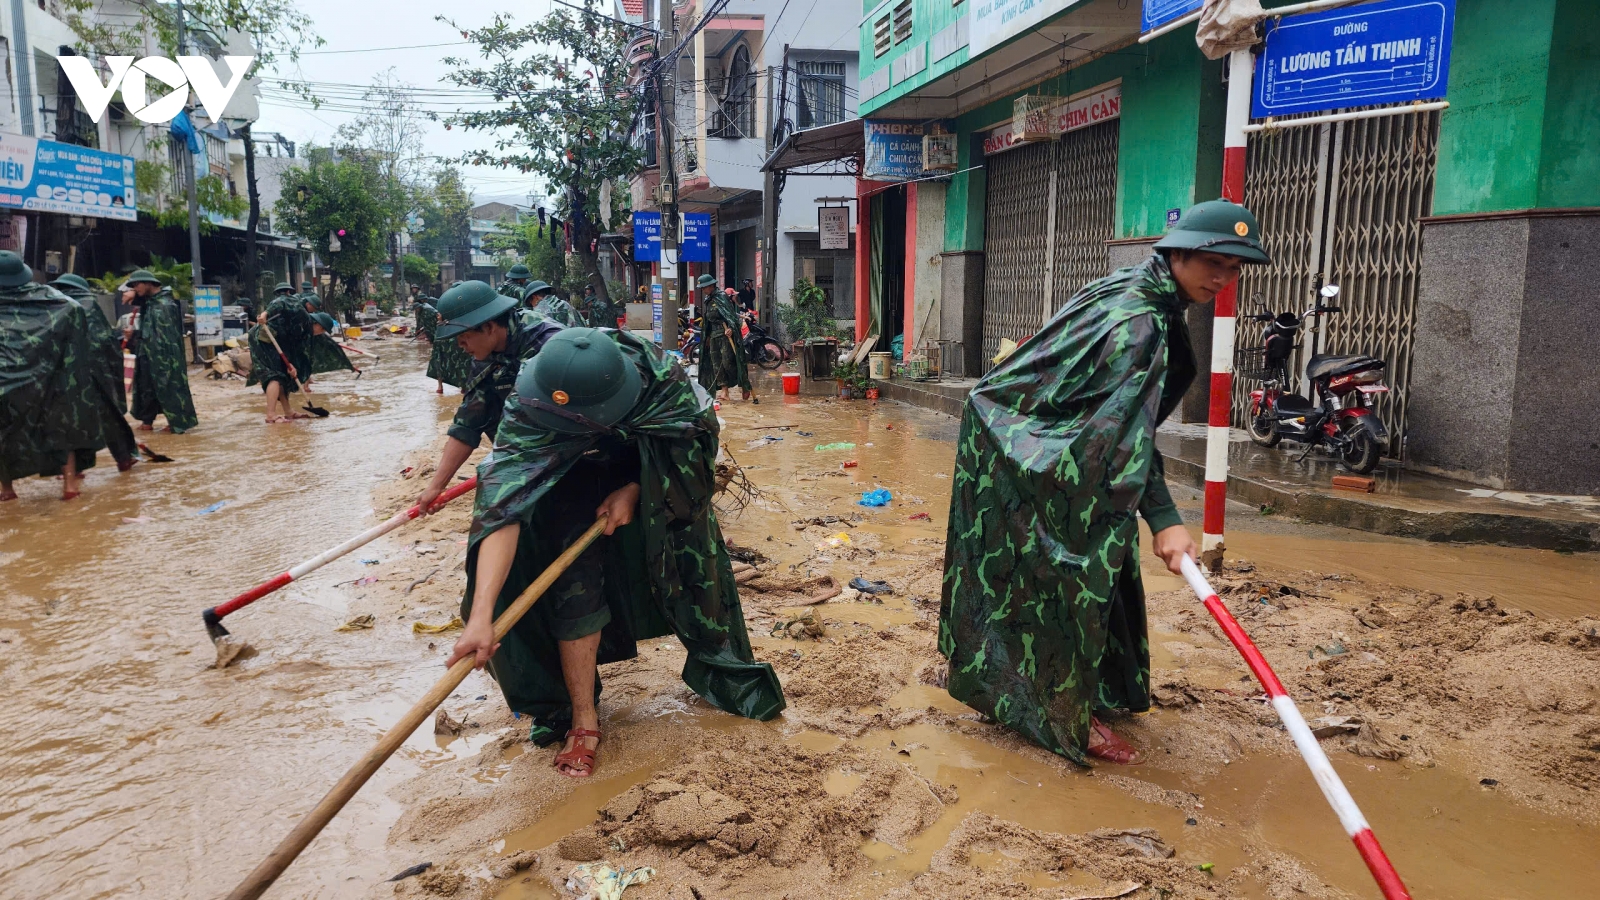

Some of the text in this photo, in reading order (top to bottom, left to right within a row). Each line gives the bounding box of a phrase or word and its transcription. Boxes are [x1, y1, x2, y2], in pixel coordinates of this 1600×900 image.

[1333, 21, 1369, 37] ĐƯỜNG
[1281, 37, 1422, 74] LƯƠNG TẤN THỊNH
[1058, 106, 1089, 131] CHIM
[1091, 94, 1121, 121] CẢN
[889, 139, 920, 151] CÁ CẢNH
[984, 133, 1005, 153] BÁN
[889, 152, 923, 164] CHIM CẢN
[0, 156, 25, 186] IỆN
[1169, 211, 1178, 221] 35
